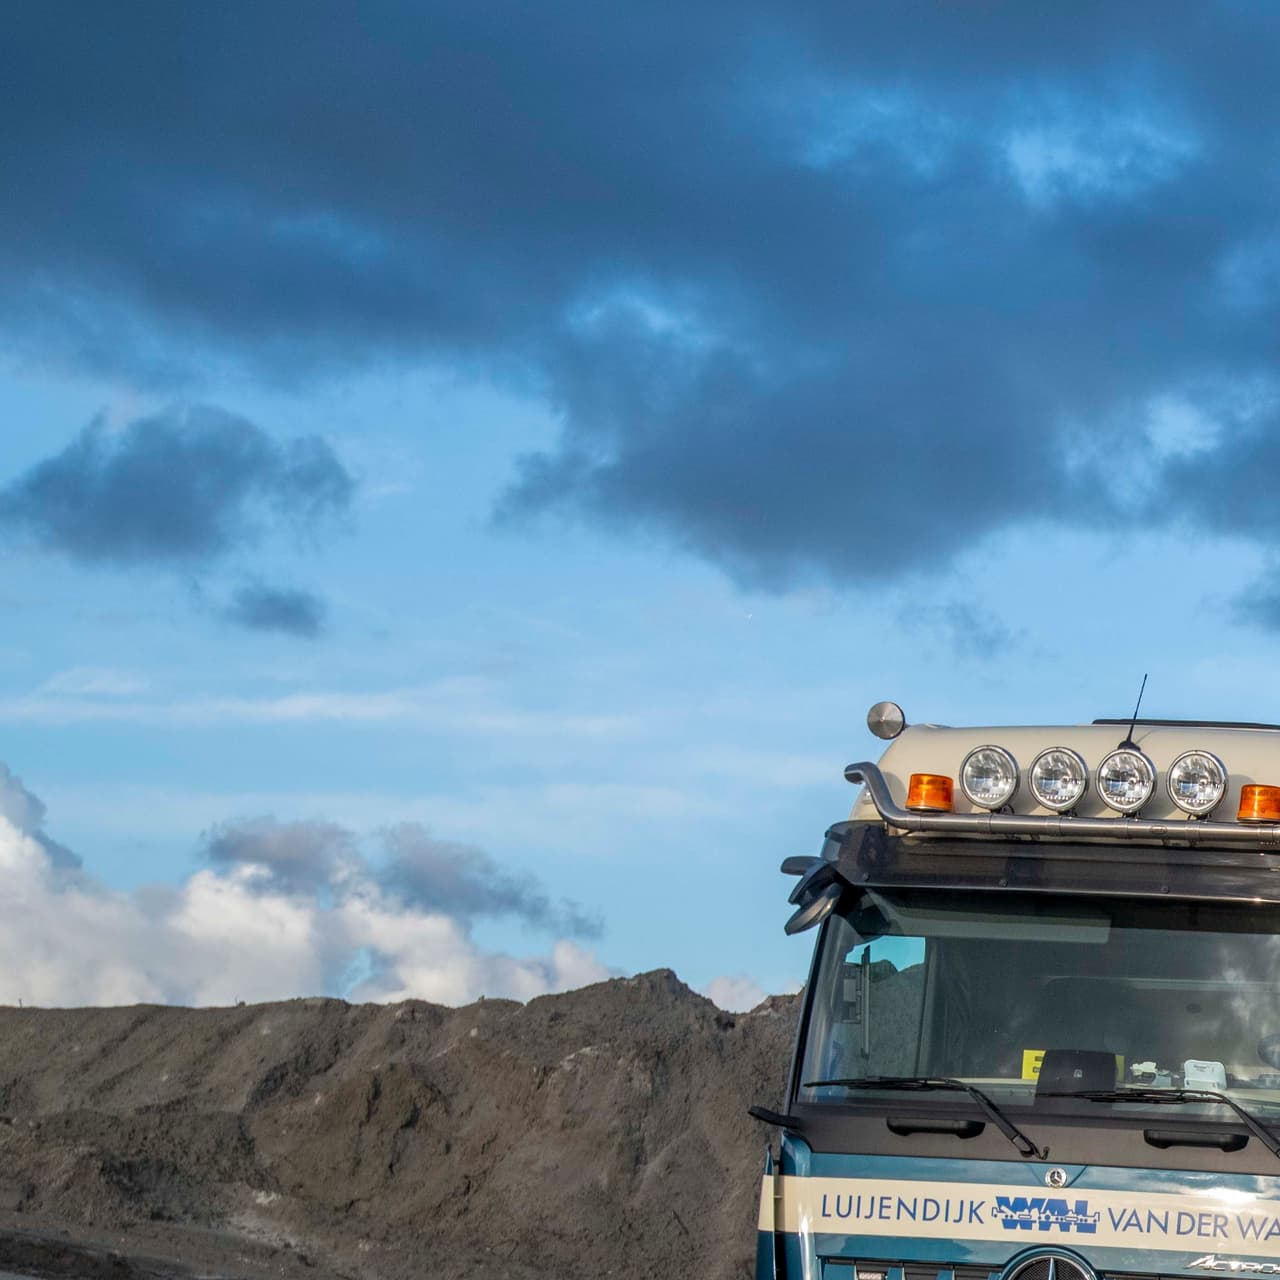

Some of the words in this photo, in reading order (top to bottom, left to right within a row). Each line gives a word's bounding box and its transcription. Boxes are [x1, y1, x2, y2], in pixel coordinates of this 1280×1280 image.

[821, 1193, 987, 1225] LUIJENDIJK
[995, 1195, 1098, 1234] WAL
[1107, 1206, 1175, 1235] VAN
[1176, 1211, 1229, 1239] DER
